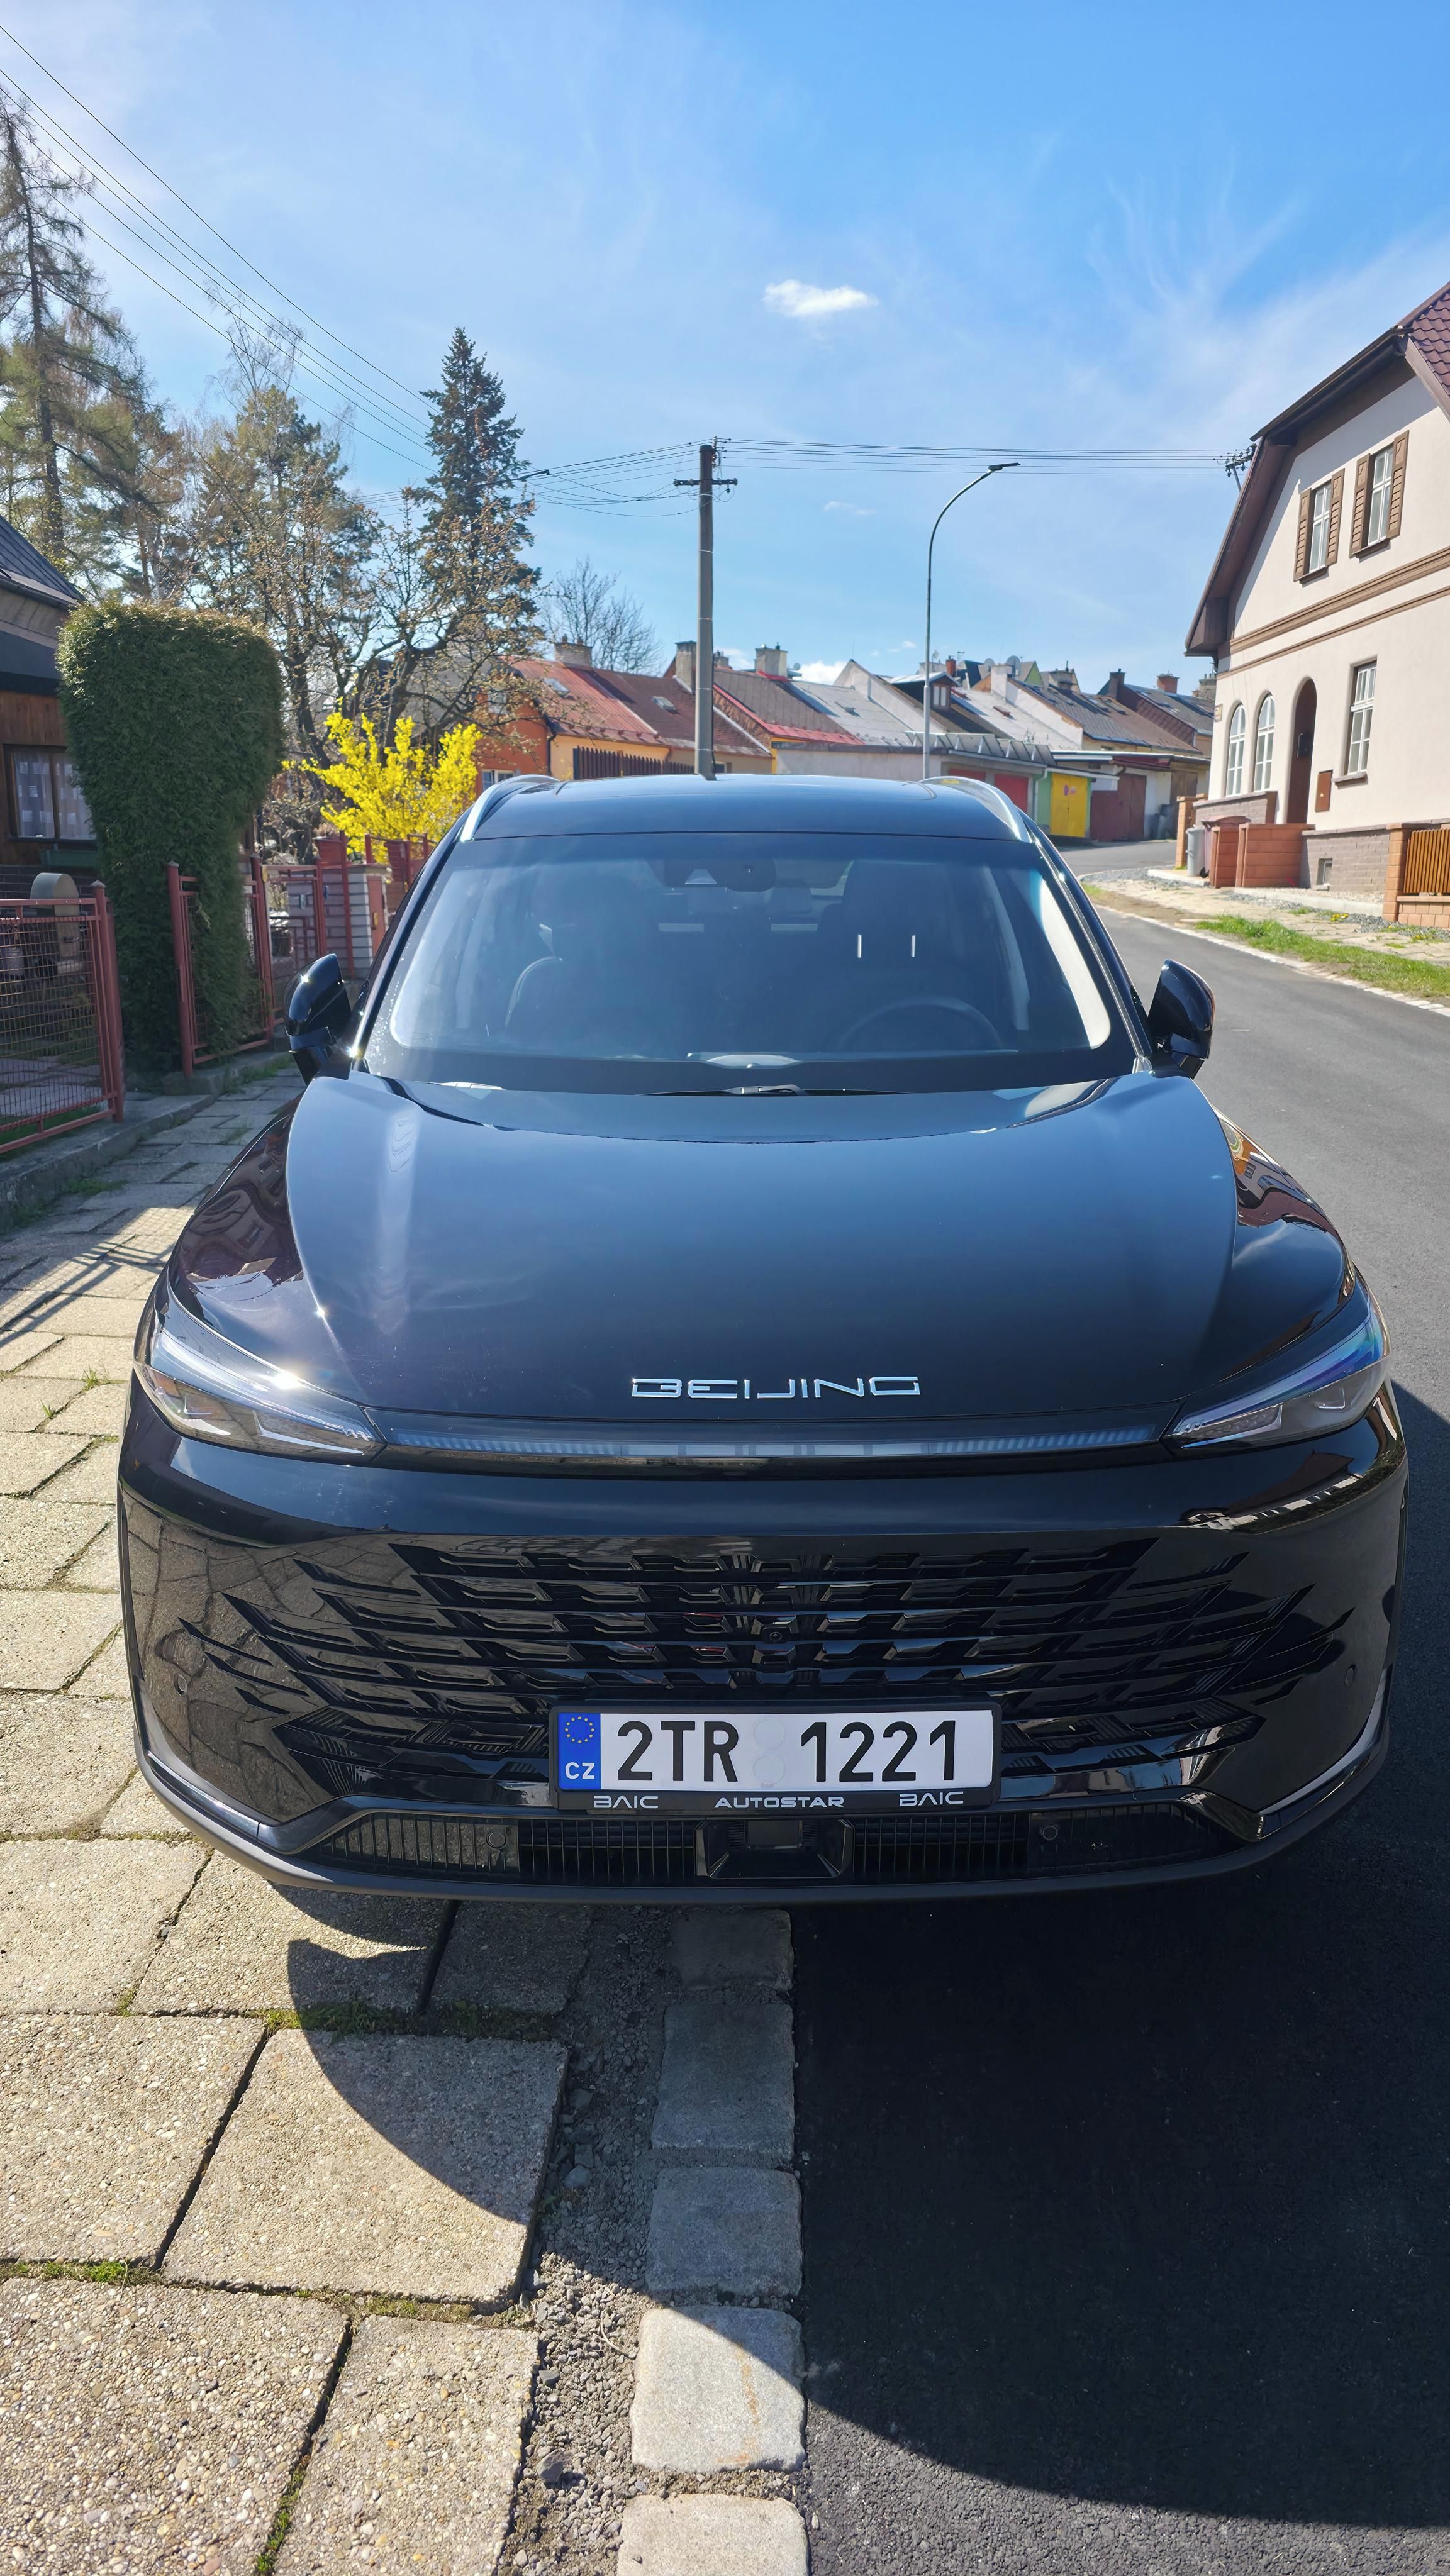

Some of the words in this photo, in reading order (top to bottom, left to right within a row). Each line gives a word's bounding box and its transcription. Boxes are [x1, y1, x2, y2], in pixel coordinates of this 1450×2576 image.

[632, 1376, 921, 1399] BEIJING
[617, 1720, 739, 1782] 2TR
[801, 1720, 956, 1782] 1221
[566, 1762, 596, 1780] CZ
[593, 1796, 659, 1809] BAIC
[713, 1796, 845, 1809] AUTOSTAR
[899, 1791, 964, 1807] BAIC
